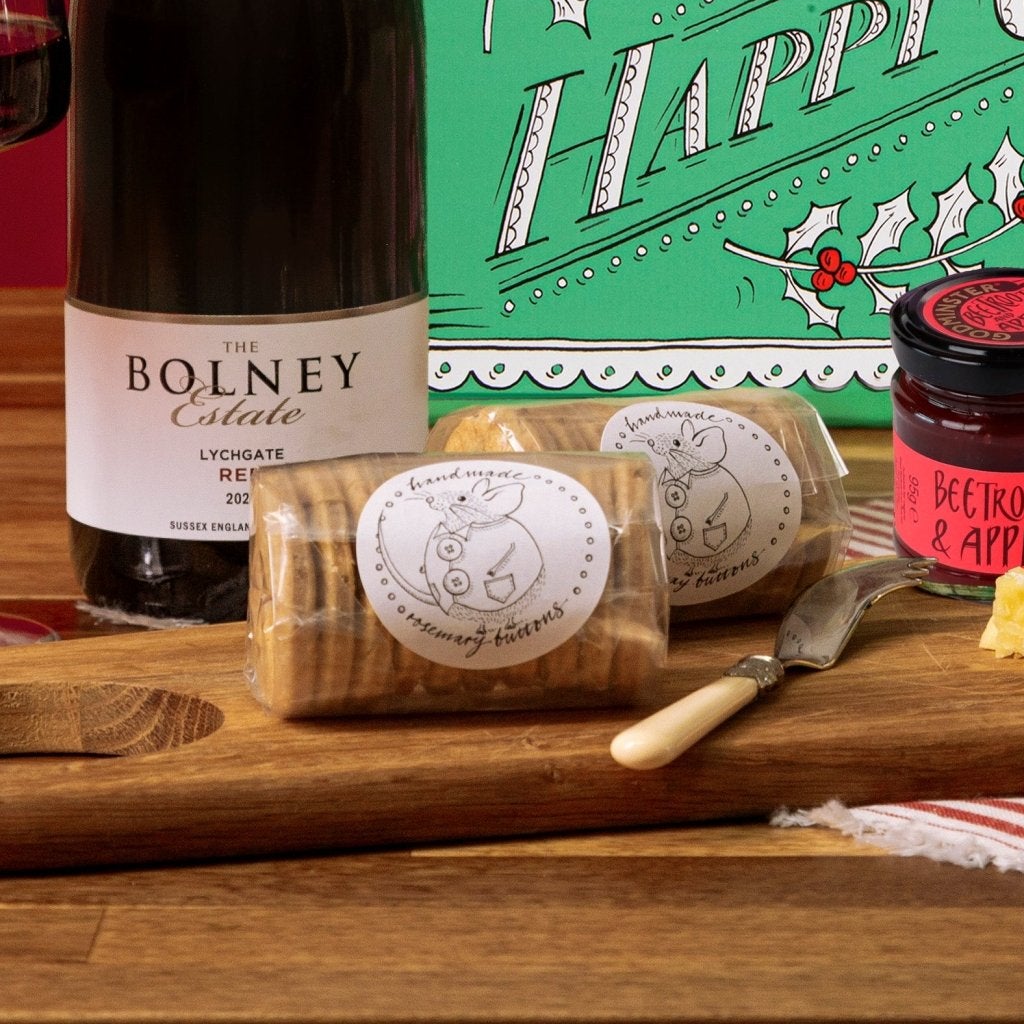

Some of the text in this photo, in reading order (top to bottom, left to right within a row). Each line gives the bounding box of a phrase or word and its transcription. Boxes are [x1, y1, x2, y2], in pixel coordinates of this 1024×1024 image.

[936, 283, 1012, 341] GODMINSTER
[222, 341, 259, 353] THE
[126, 351, 361, 396] BOLNEY
[170, 376, 306, 427] Estate
[624, 407, 724, 432] handmade
[200, 448, 285, 461] LYCHGATE
[219, 467, 254, 482] RE
[407, 467, 528, 491] handmade
[226, 492, 249, 505] 202
[169, 521, 249, 532] SUSSEX ENGLAN
[931, 519, 951, 558] &
[696, 549, 764, 589] buttons
[406, 599, 568, 658] rosemary buttons
